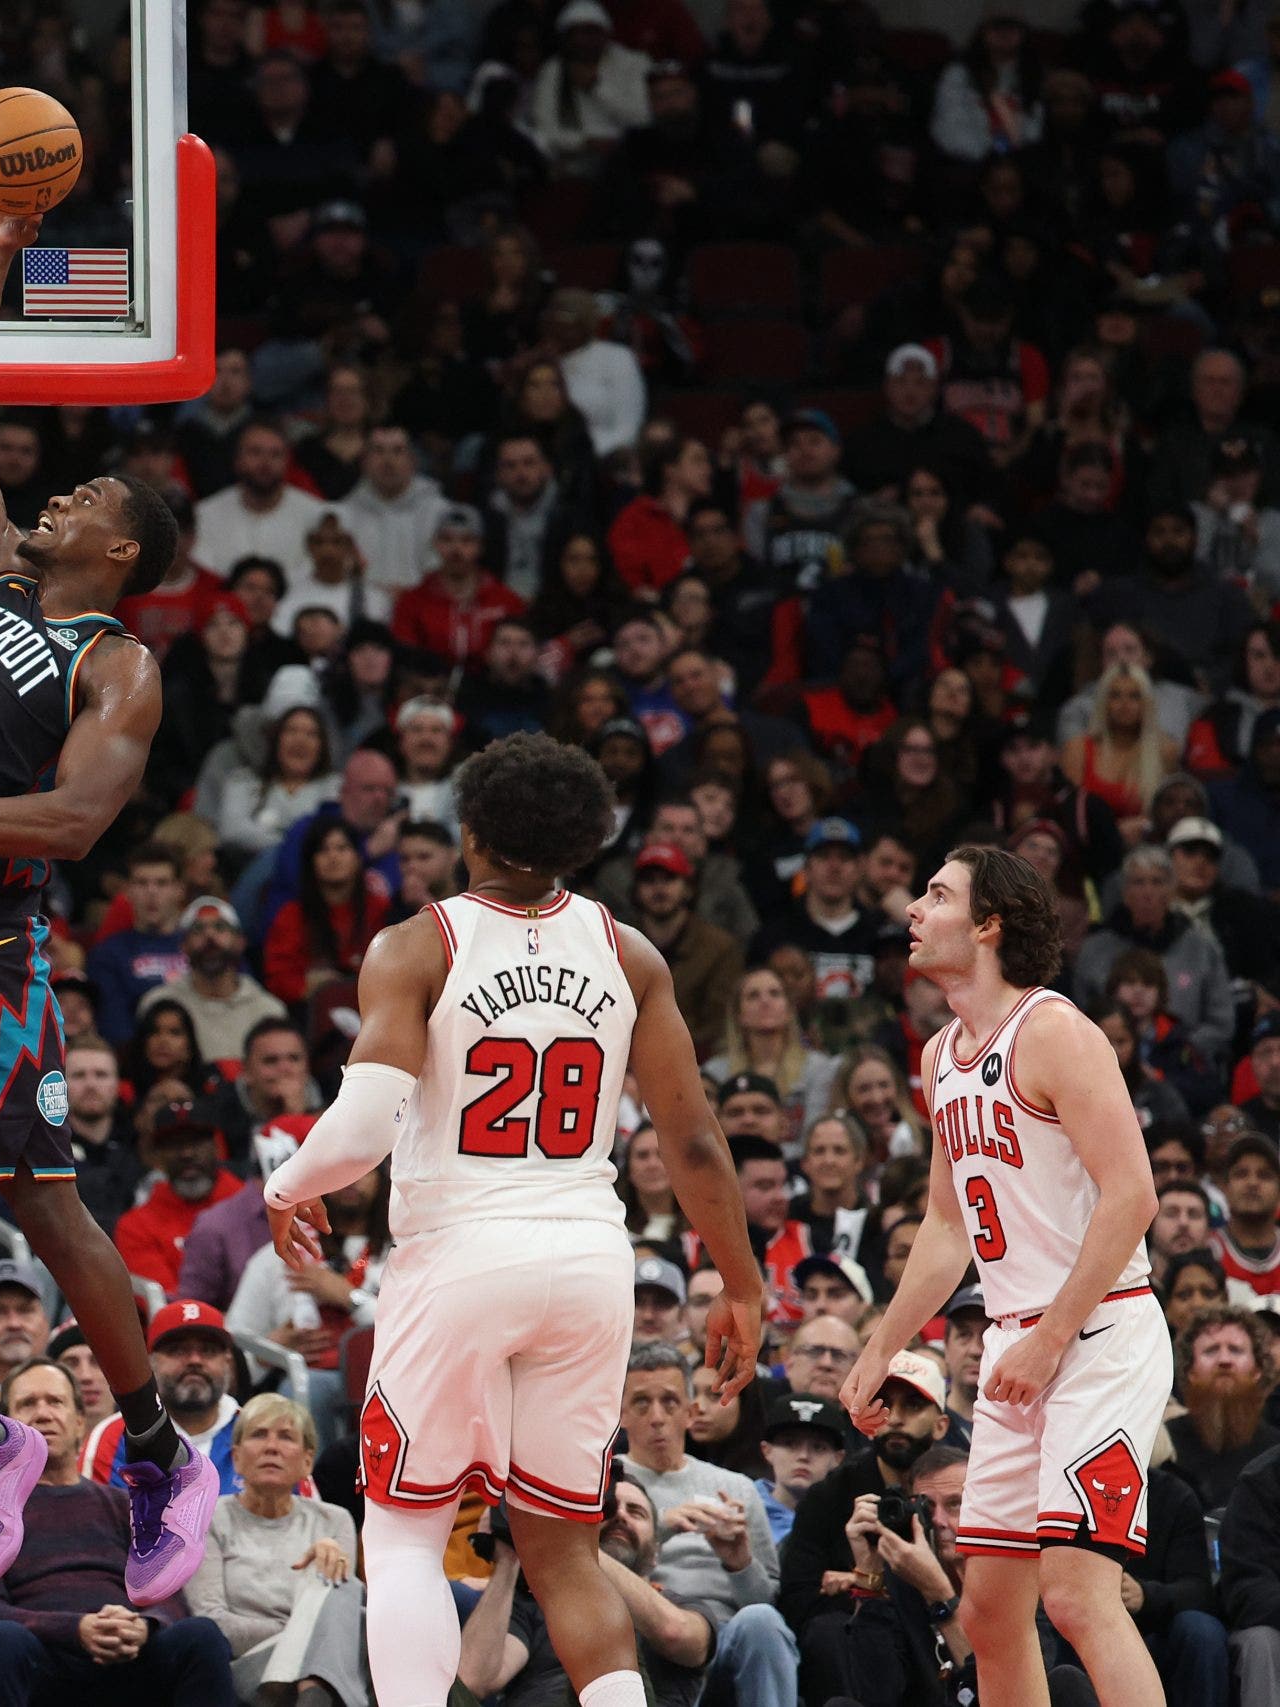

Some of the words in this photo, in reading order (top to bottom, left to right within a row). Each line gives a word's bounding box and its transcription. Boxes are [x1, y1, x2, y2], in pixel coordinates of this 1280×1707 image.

[460, 965, 616, 1029] YABUSELE
[458, 1036, 605, 1159] 28
[934, 1095, 1024, 1169] BULLS
[965, 1175, 1007, 1263] 3
